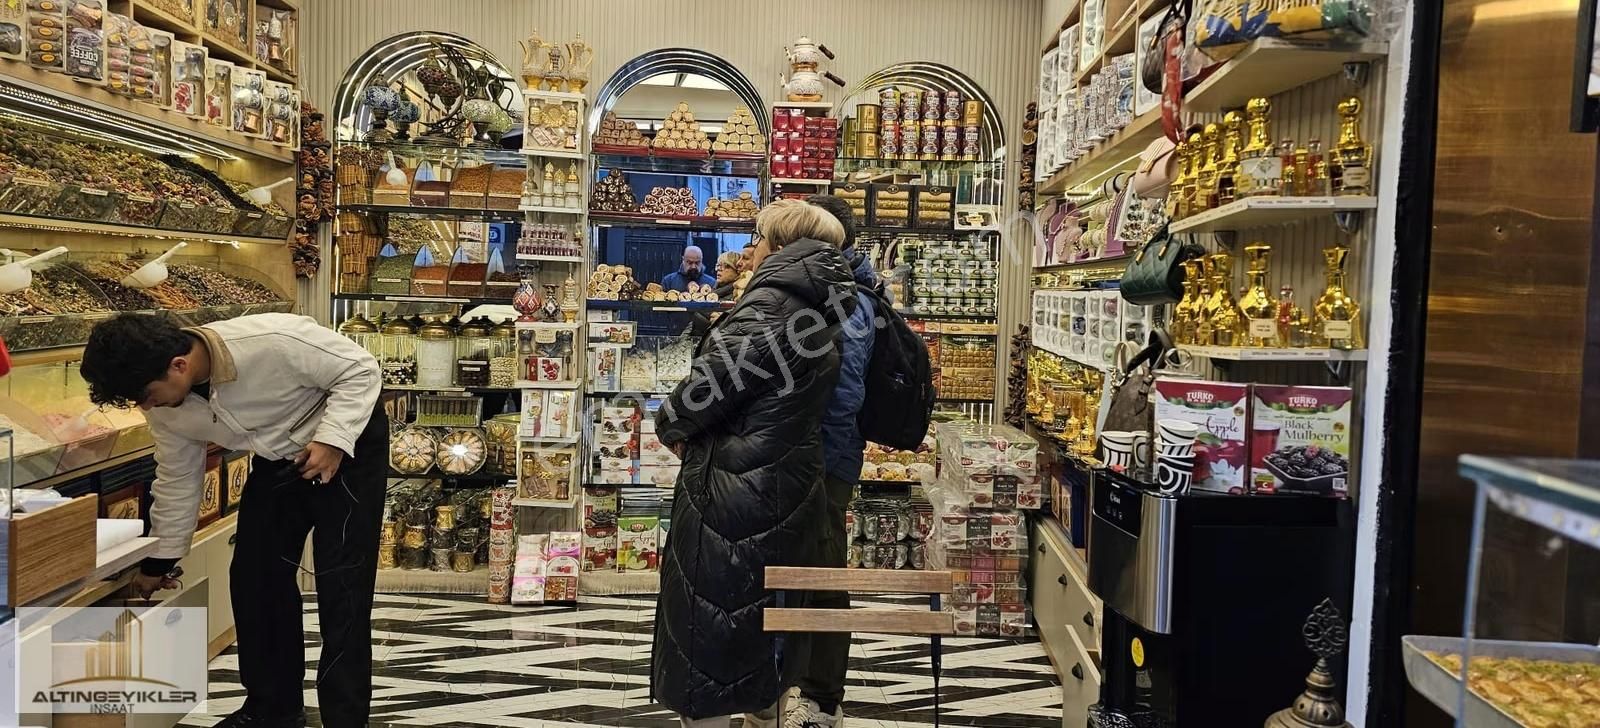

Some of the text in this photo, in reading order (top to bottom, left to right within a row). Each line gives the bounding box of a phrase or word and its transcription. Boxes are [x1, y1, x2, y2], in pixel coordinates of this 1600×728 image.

[70, 47, 98, 62] COFFEE
[1186, 391, 1214, 401] TURKO
[1288, 396, 1318, 405] TURKO
[1197, 416, 1239, 437] Apple
[1284, 420, 1314, 430] Black
[1285, 430, 1343, 443] Mulberry
